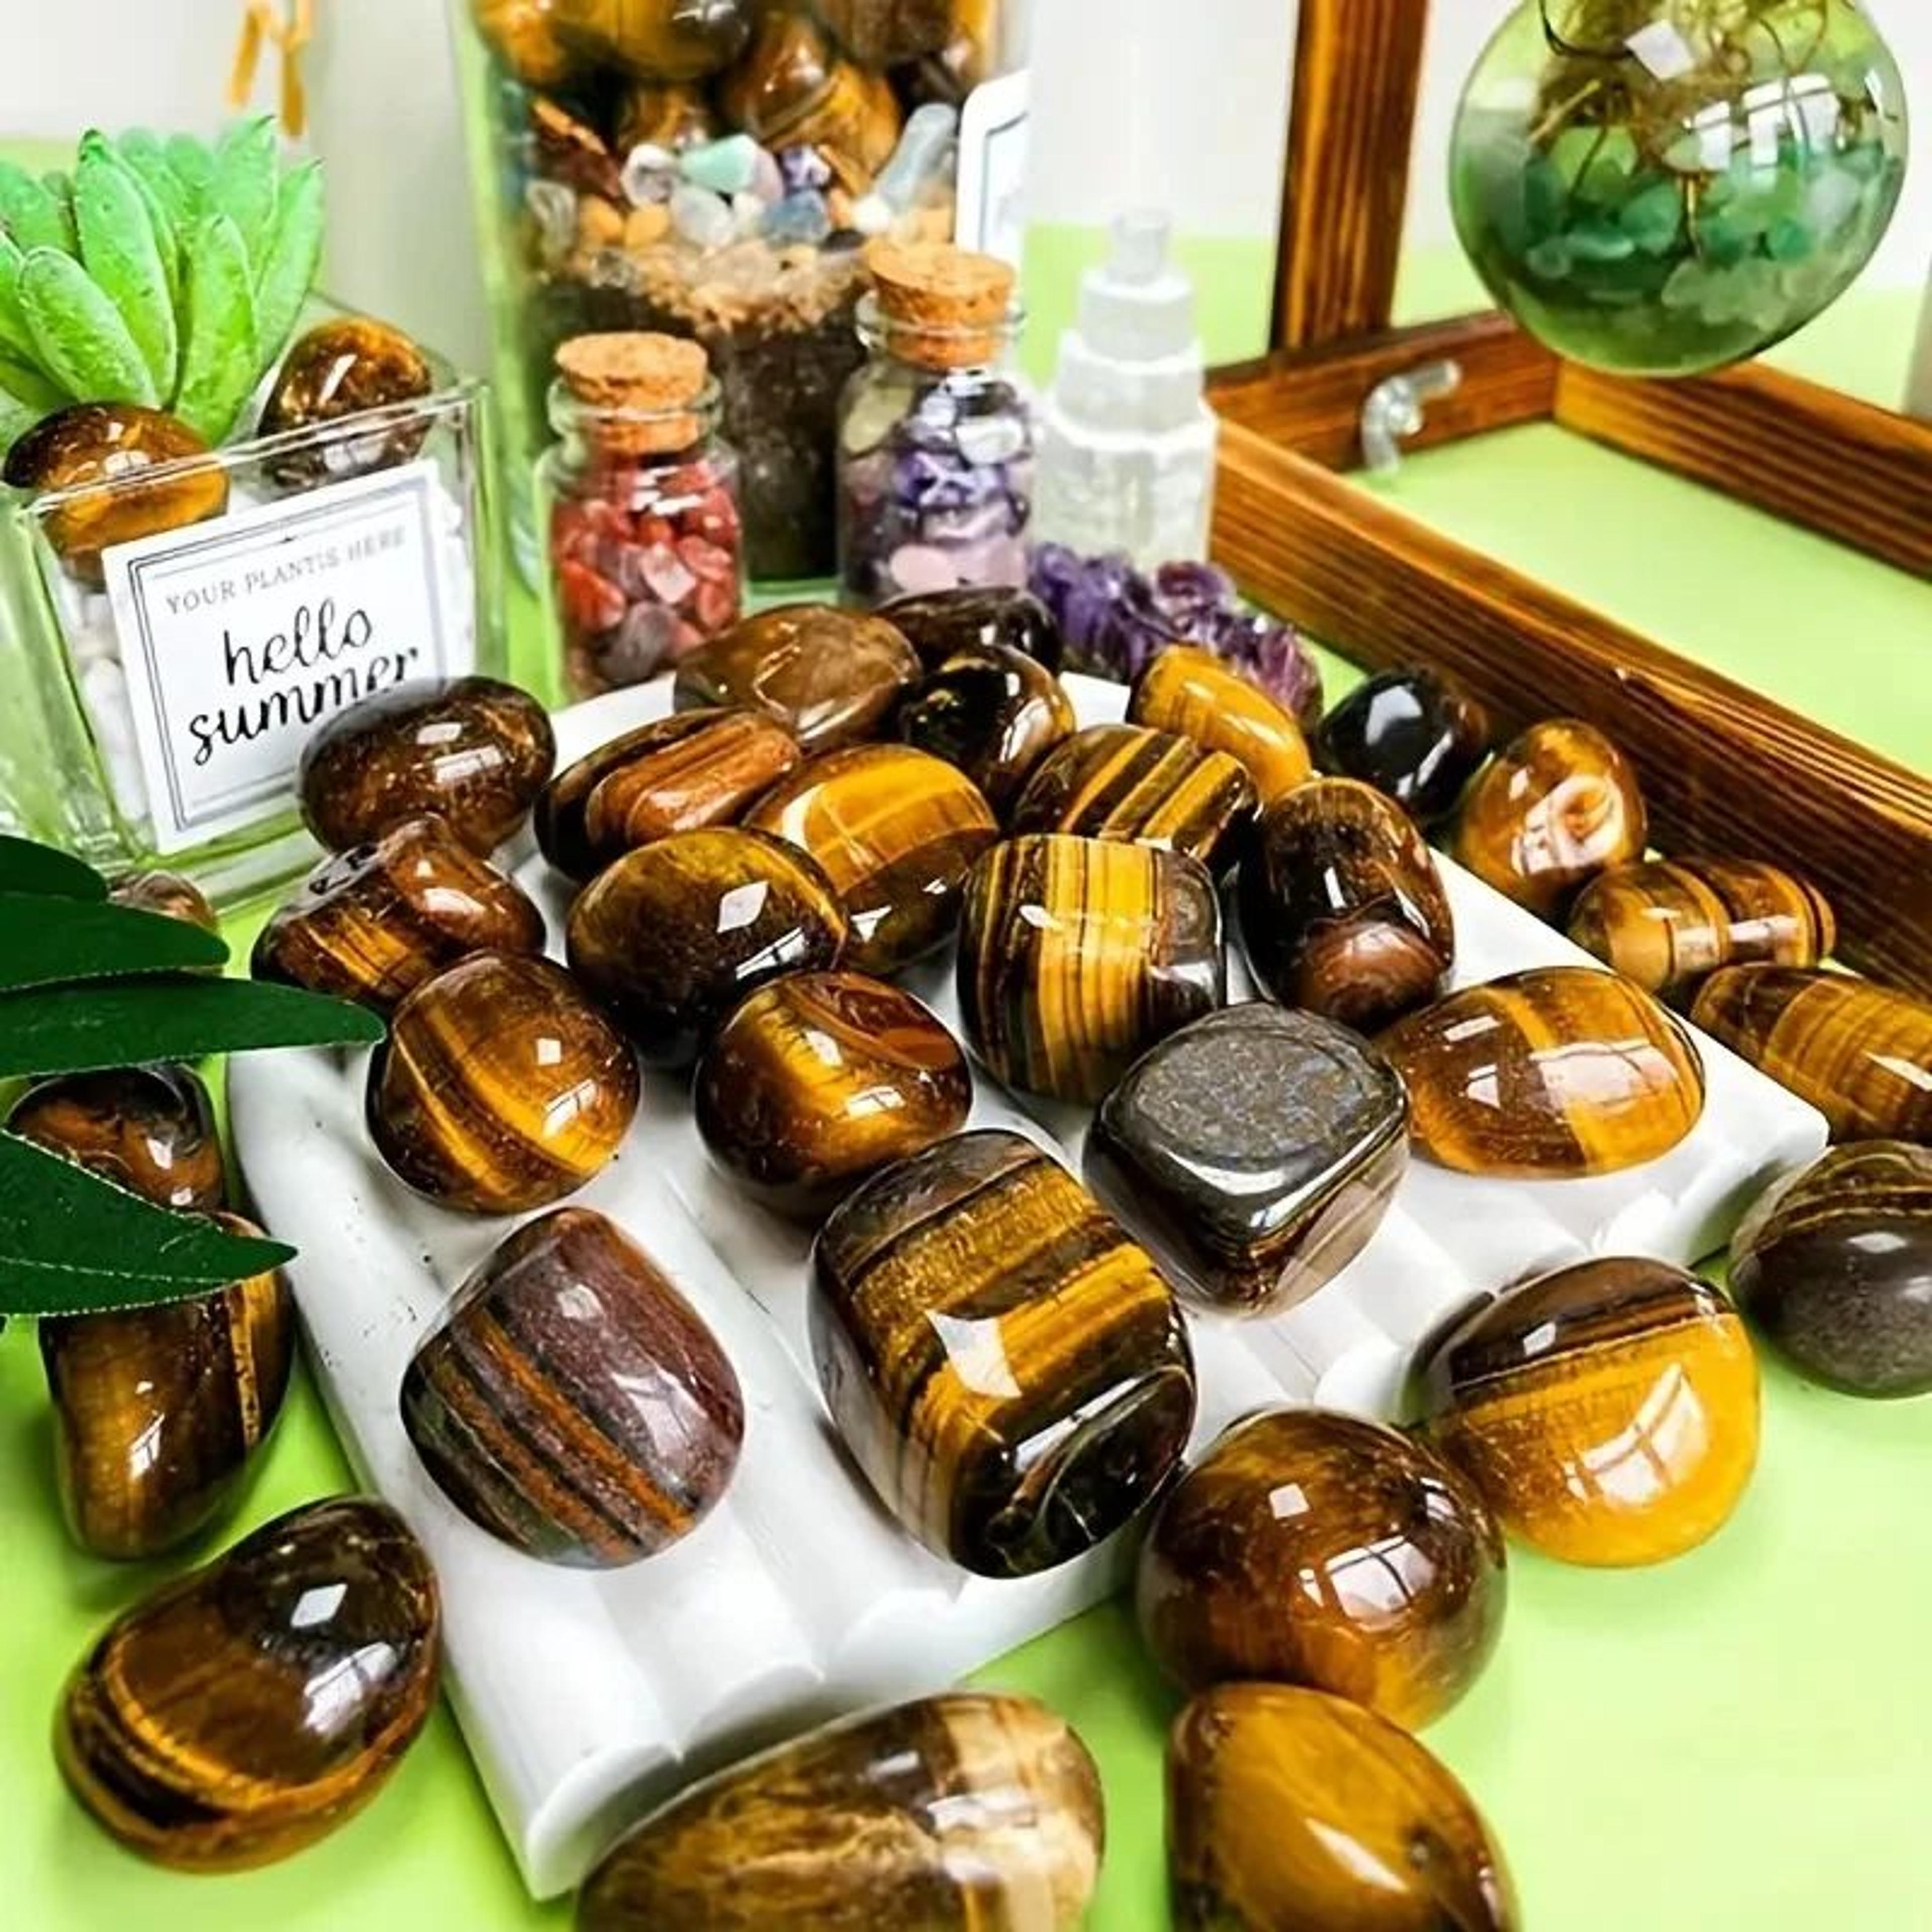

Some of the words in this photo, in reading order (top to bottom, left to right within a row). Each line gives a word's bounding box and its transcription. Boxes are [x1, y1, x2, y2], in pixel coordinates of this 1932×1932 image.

[166, 580, 236, 614] YOUR
[347, 525, 406, 561] HERE
[224, 598, 372, 686] hello
[189, 647, 419, 766] summer
